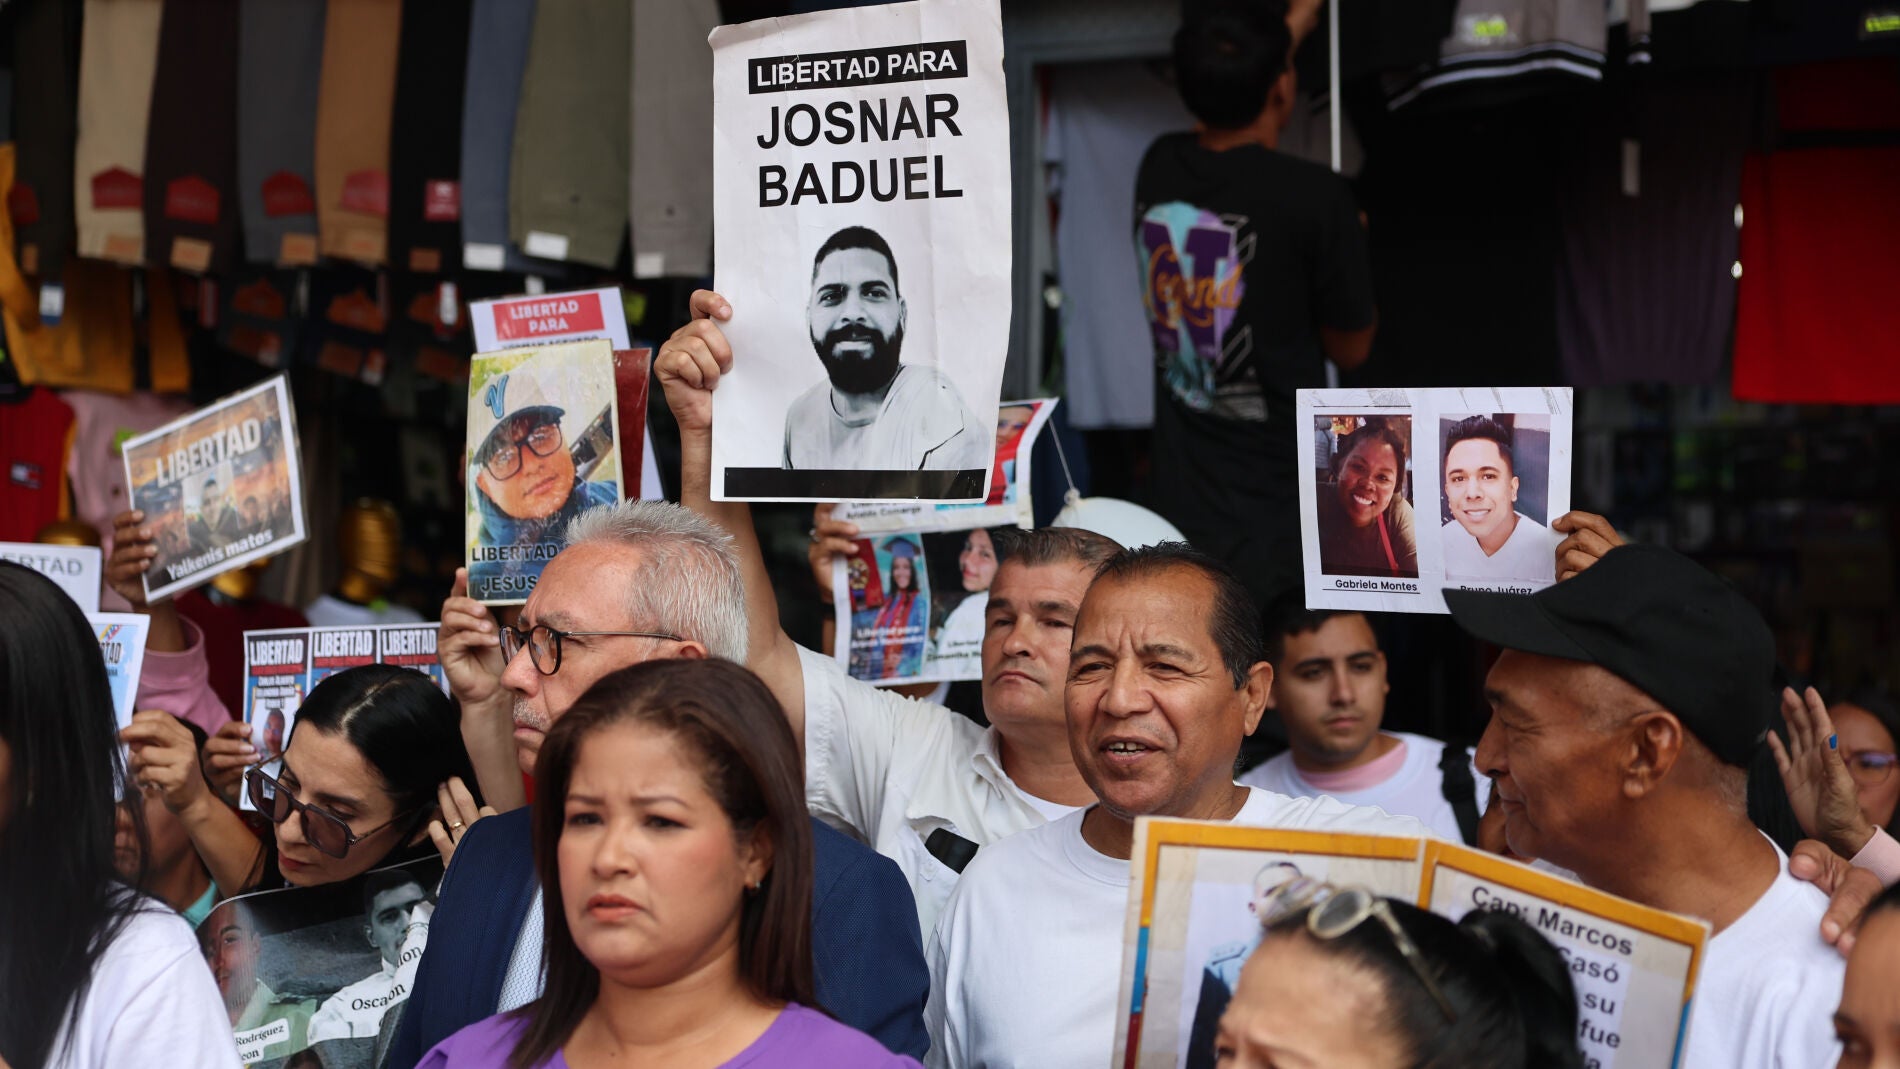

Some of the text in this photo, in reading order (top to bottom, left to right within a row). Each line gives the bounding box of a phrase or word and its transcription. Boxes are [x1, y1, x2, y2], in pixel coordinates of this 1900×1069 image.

[756, 49, 958, 87] LIBERTAD PARA
[756, 93, 963, 149] JOSNAR
[759, 154, 963, 208] BADUEL
[510, 299, 580, 320] LIBERTAD
[528, 317, 570, 334] PARA
[154, 417, 263, 489] LIBERTAD
[166, 528, 274, 581] Yalkenis matos
[471, 544, 559, 562] LIBERTAD
[481, 575, 537, 592] JESUS
[1335, 579, 1418, 592] Gabriela Montes
[250, 639, 304, 666] LIBERTAD
[313, 630, 374, 658] LIBERTAD
[382, 629, 437, 655] LIBERTAD
[1537, 908, 1633, 956] Marcos
[1583, 992, 1616, 1016] su
[235, 1024, 285, 1047] Rodríguez
[1579, 1018, 1621, 1049] fue
